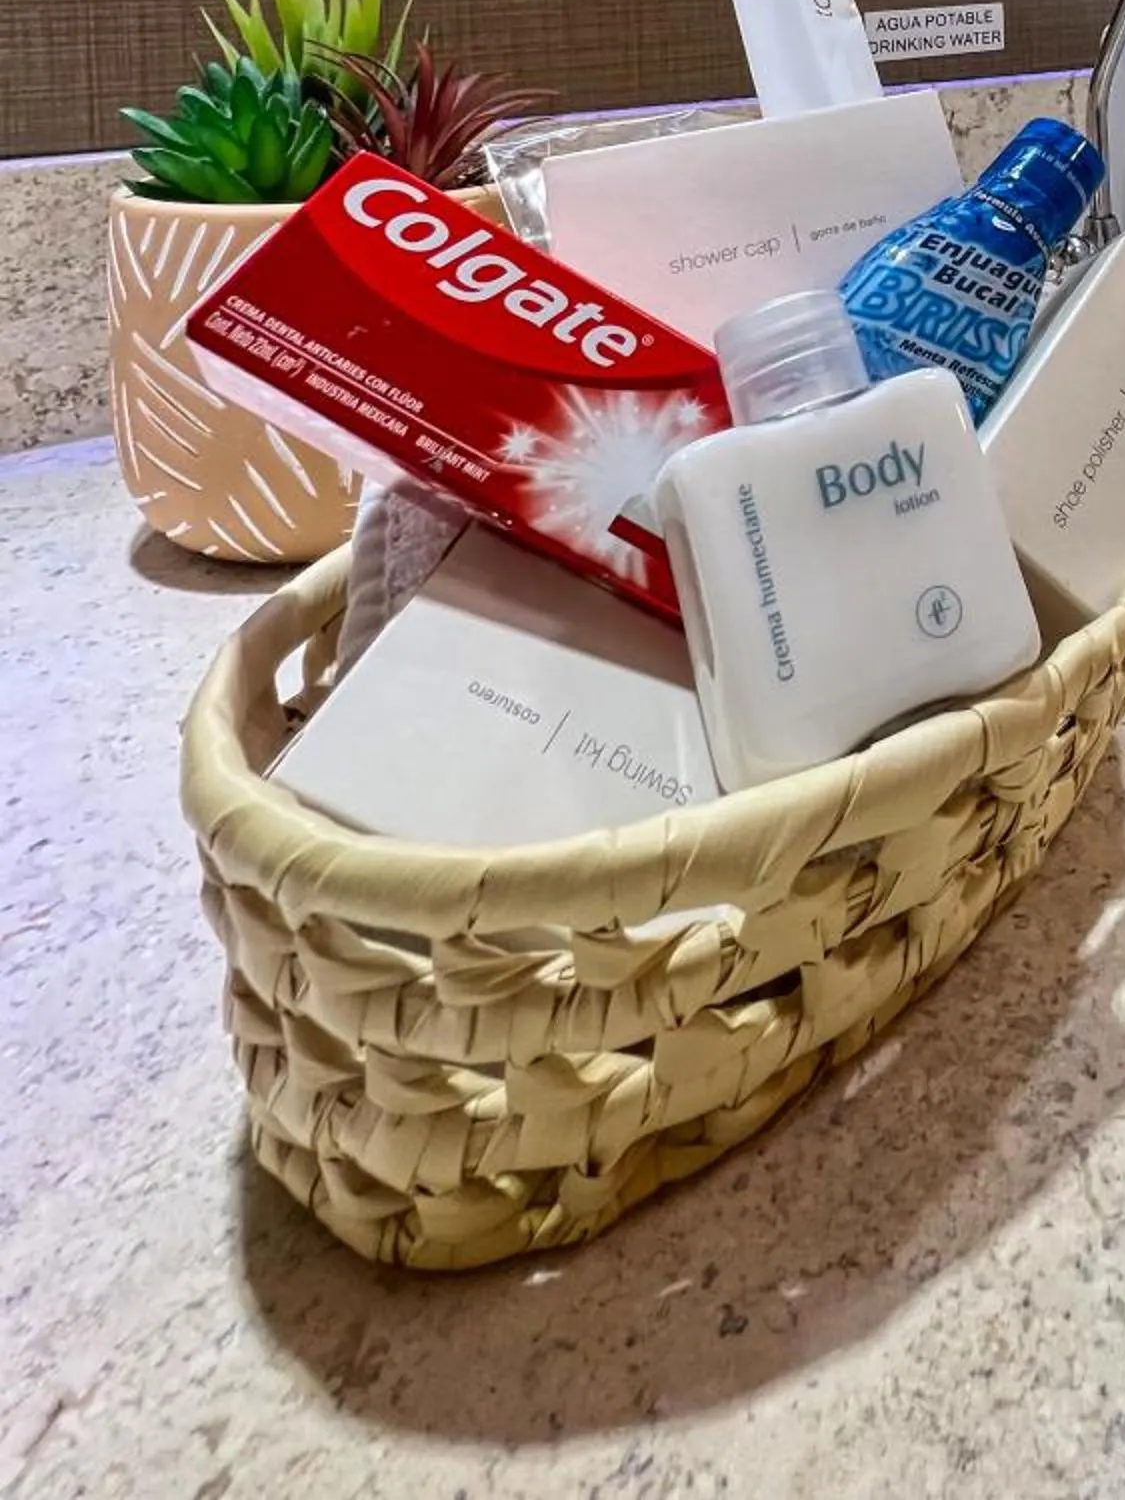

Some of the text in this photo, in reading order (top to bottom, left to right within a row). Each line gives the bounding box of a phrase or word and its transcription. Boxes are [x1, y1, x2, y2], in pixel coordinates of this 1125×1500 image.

[876, 9, 993, 31] AGUA POTABLE
[949, 29, 1001, 48] WATER
[343, 178, 638, 367] Colgate
[668, 235, 781, 275] shower cap
[932, 263, 1017, 314] Bucal
[225, 295, 266, 322] CREMA
[262, 317, 305, 346] DENTAL
[303, 340, 368, 381] ANTICARIES
[364, 375, 390, 395] CON
[899, 338, 947, 365] Menta
[305, 372, 409, 437] INDUSTRIA MEXICANA
[815, 440, 926, 510] Body
[893, 488, 942, 516] lotion
[1053, 479, 1088, 529] shoe
[738, 483, 796, 683] Crema humectante
[467, 680, 542, 725] costurero
[574, 732, 693, 807] sewing kit
